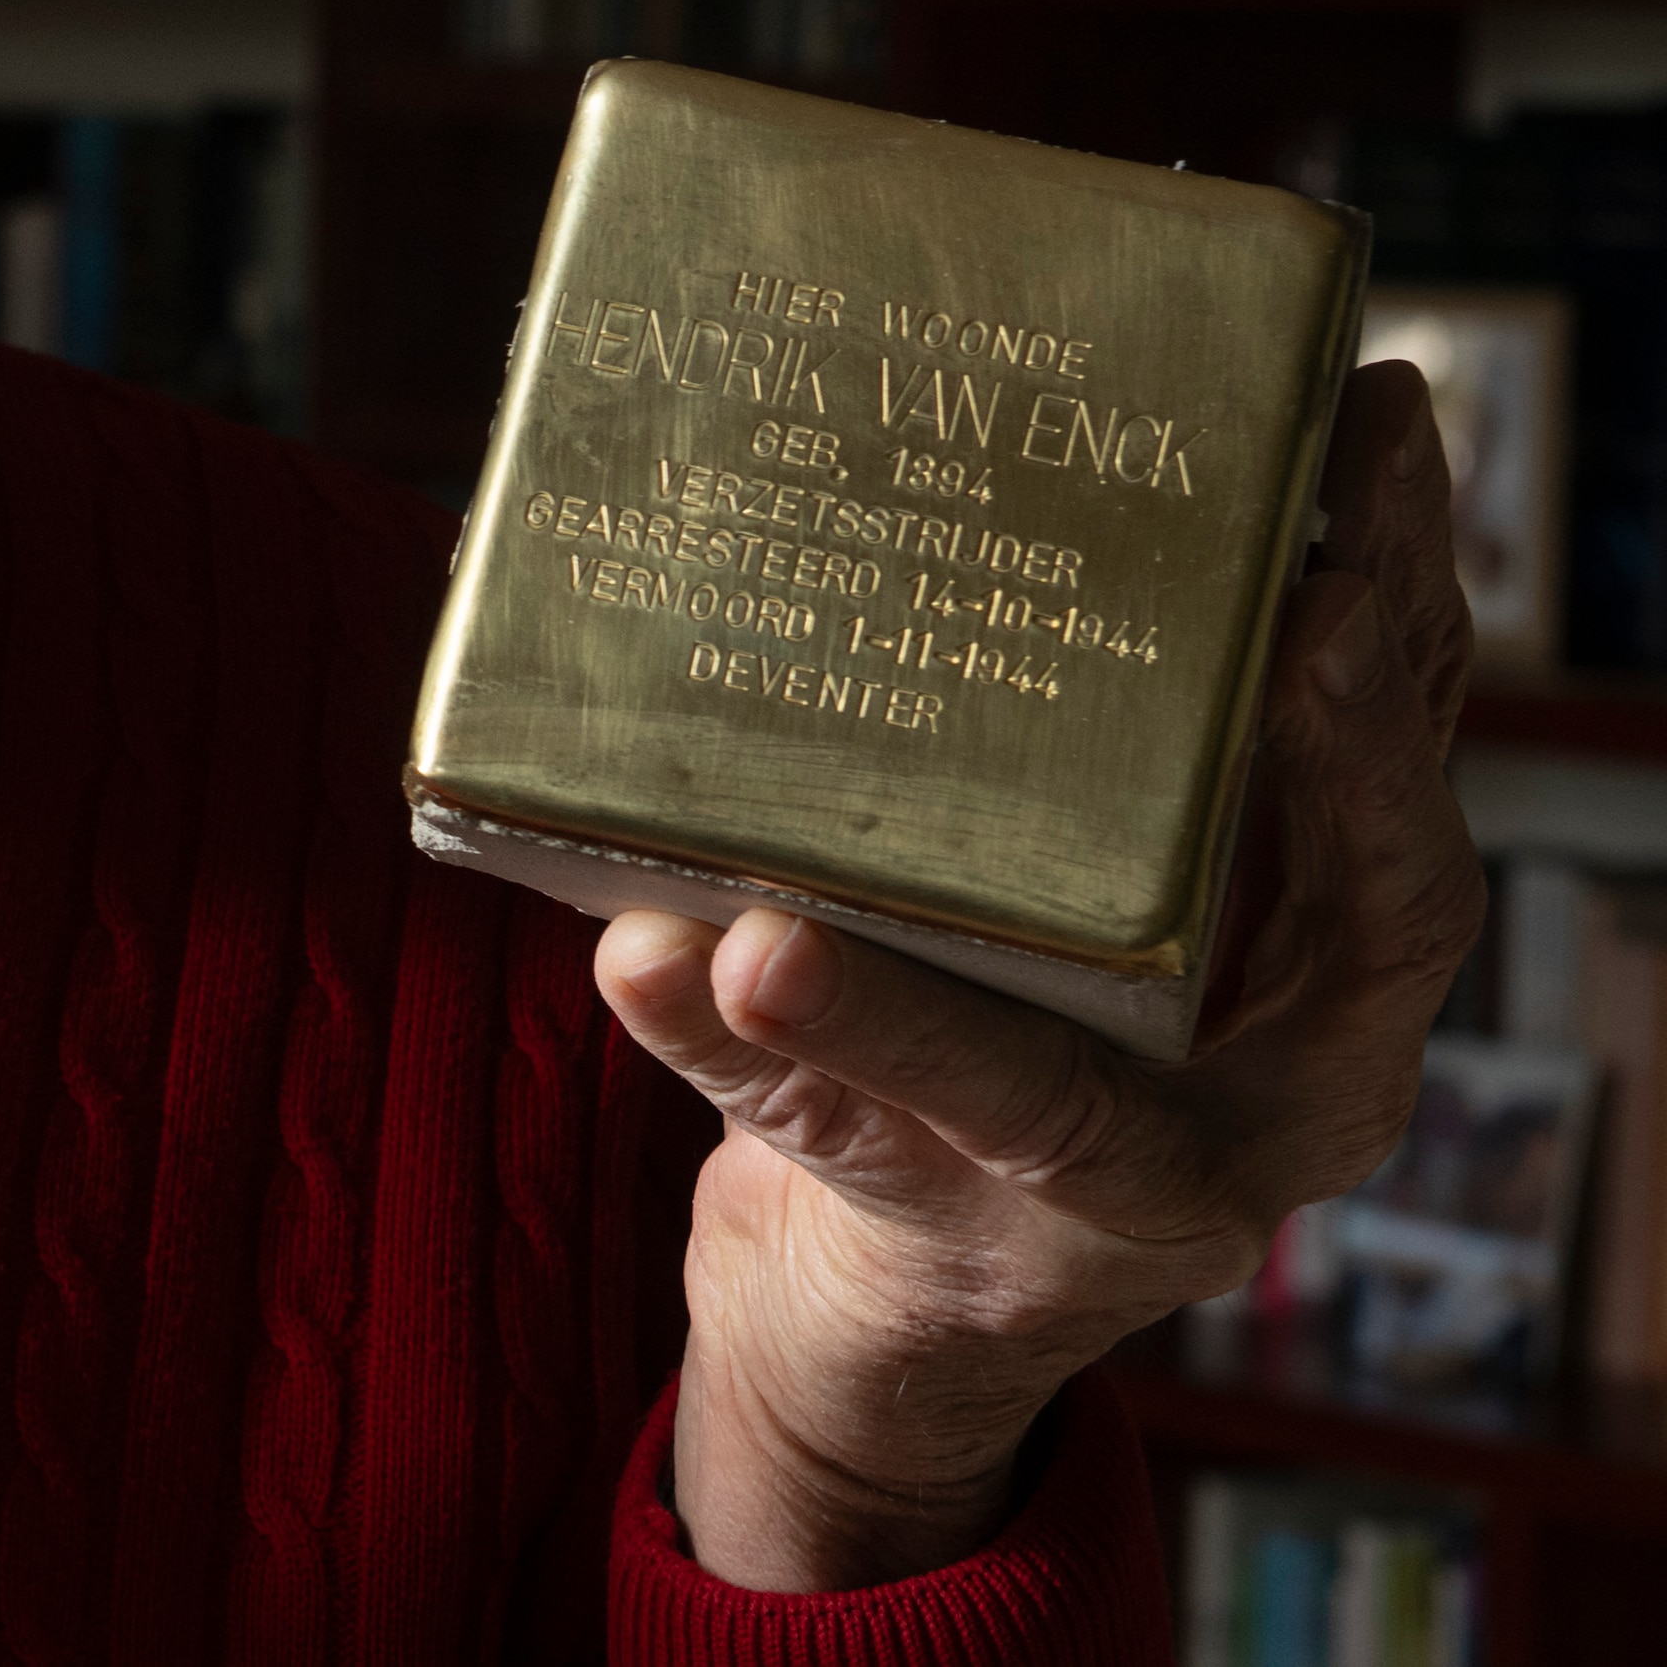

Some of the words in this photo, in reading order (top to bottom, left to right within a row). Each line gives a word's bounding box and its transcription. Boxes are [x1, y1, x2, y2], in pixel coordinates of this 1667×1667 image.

[733, 271, 845, 327] HIER
[883, 301, 1094, 380] WOONDE
[546, 291, 841, 414] HENDRIK
[881, 356, 1002, 449] VAN
[1021, 392, 1209, 496] ENCK
[659, 458, 1083, 588] VERZETSSTRIJDER
[752, 419, 849, 482] GEB.
[885, 445, 994, 505] 1894
[525, 491, 881, 599] GEARRESTEERD
[907, 573, 1159, 664] 14-10-1944
[570, 553, 816, 642] VERMOORD
[844, 616, 1060, 700] 1-11-1944
[689, 640, 943, 734] DEVENTER
